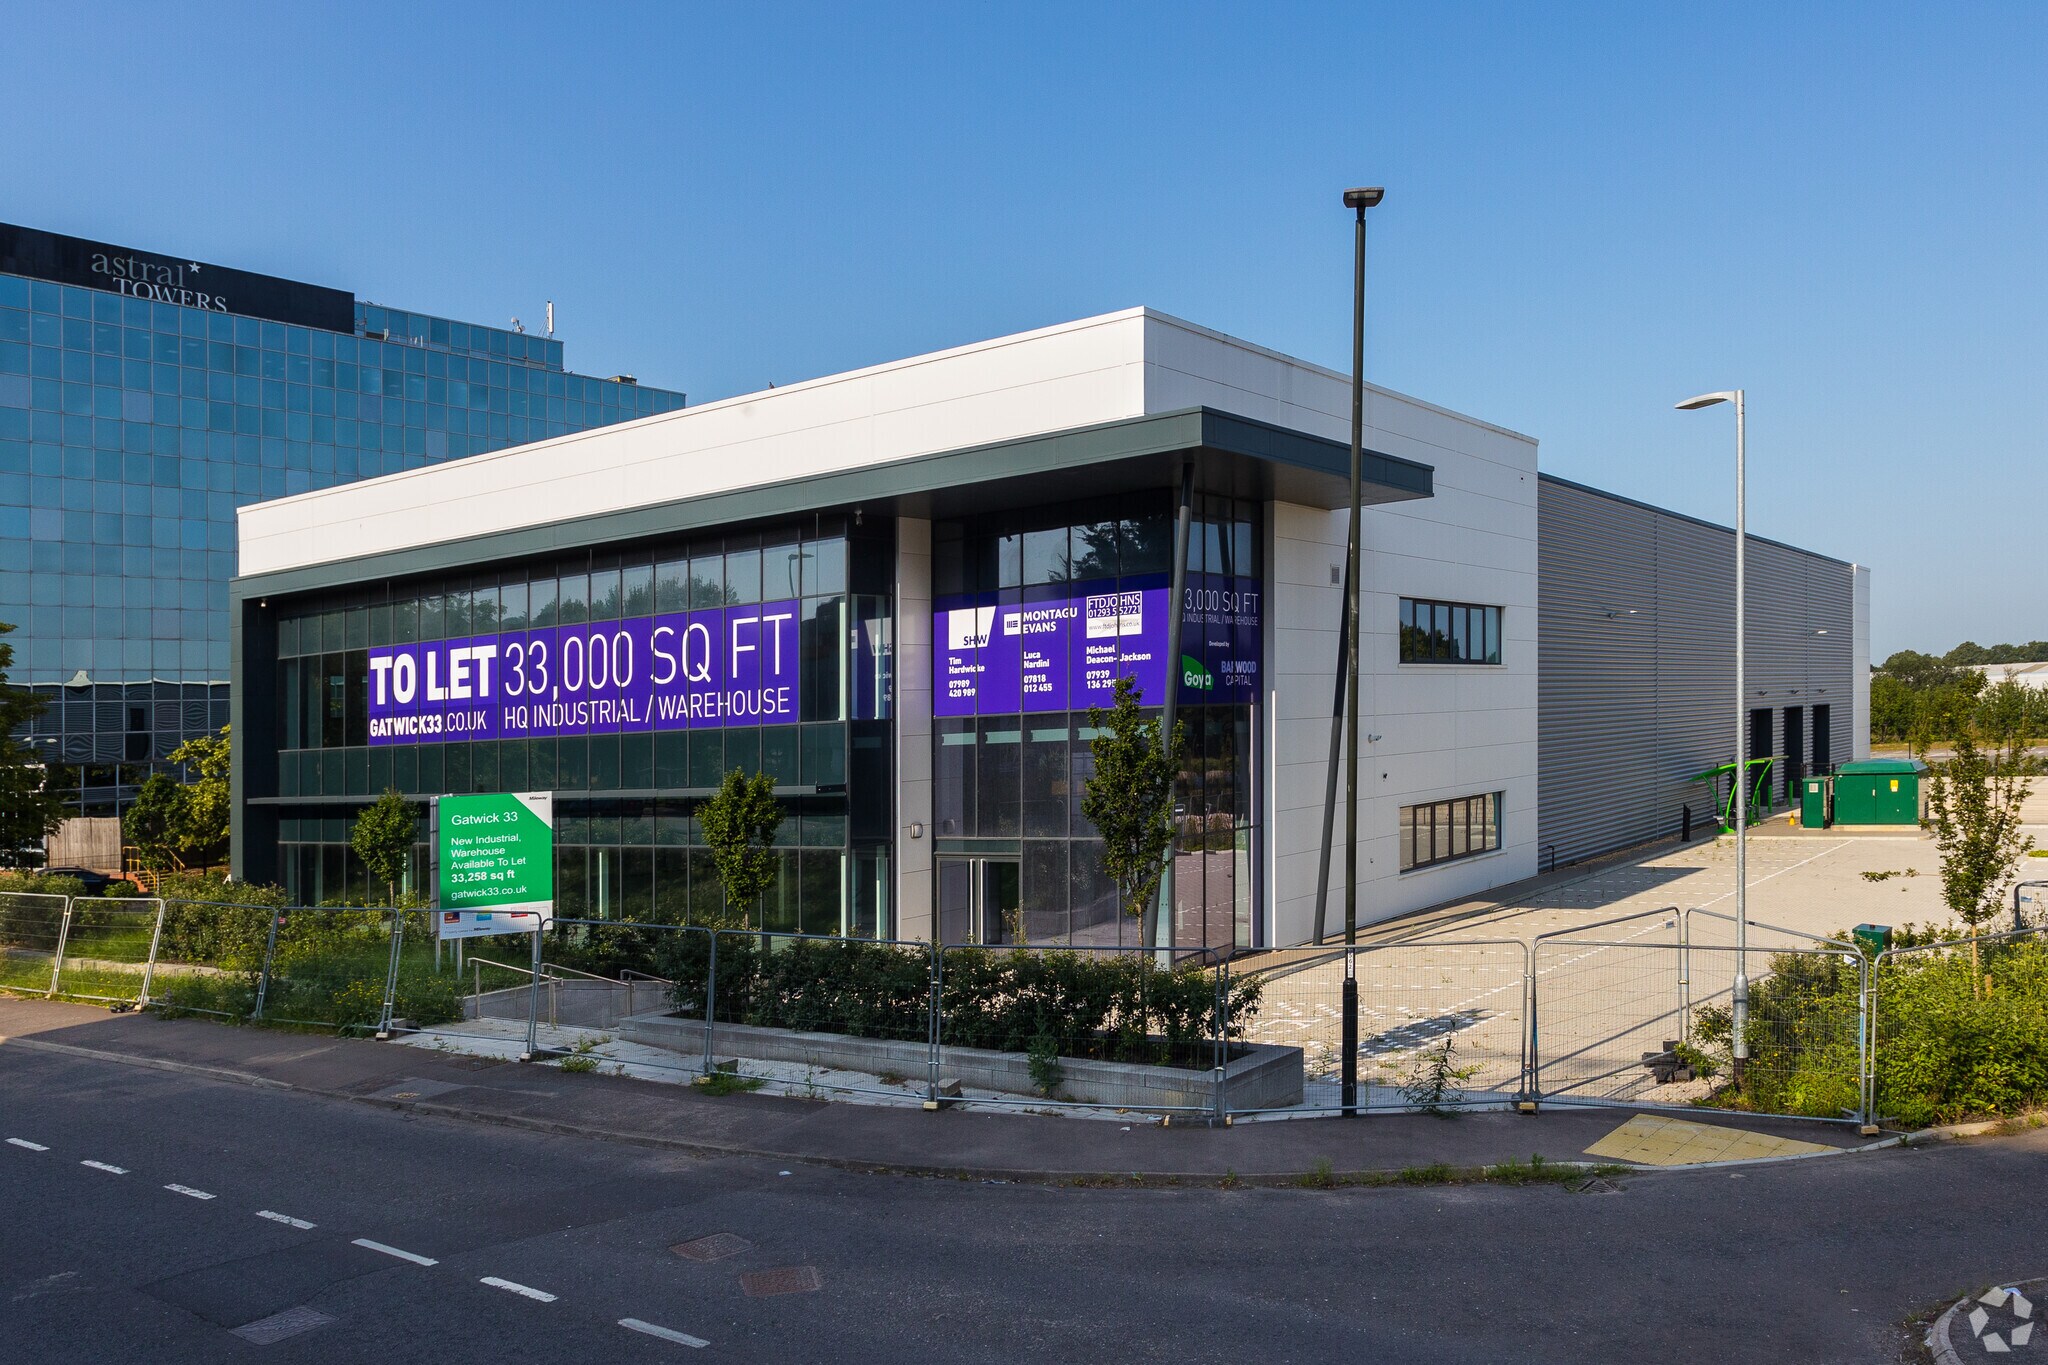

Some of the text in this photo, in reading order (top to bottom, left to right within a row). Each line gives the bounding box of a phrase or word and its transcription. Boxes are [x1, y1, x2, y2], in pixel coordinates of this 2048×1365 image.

[91, 253, 187, 288] astral
[113, 277, 227, 313] TOWERS
[1185, 588, 1259, 613] 3,000 SQ FT
[1023, 607, 1078, 622] MONTAGU
[1089, 608, 1111, 618] 01293
[1023, 622, 1057, 634] EVANS
[964, 635, 987, 646] SHW
[1087, 645, 1115, 655] Michael
[370, 614, 793, 705] TO LET 33,000 SQ FT
[949, 657, 962, 665] Tim
[1024, 652, 1041, 660] Luca
[949, 664, 985, 674] Hardwicke
[1024, 659, 1050, 669] Nardini
[1024, 674, 1046, 683] 07818
[1087, 670, 1110, 680] 07939
[1185, 671, 1212, 689] Goya
[949, 680, 970, 689] 07989
[1024, 683, 1053, 693] 012 455
[1087, 680, 1101, 689] 136
[949, 688, 976, 698] 420 989
[505, 706, 528, 730] HQ
[534, 698, 641, 728] INDUSTRIAL
[658, 687, 790, 720] WAREHOUSE
[452, 812, 518, 826] Gatwick 33
[451, 837, 473, 846] New
[451, 848, 506, 858] Warehouse
[451, 857, 526, 870] Available To Let
[452, 870, 515, 883] 33,258 sq ft
[452, 886, 527, 900] gatwick33.co.uk
